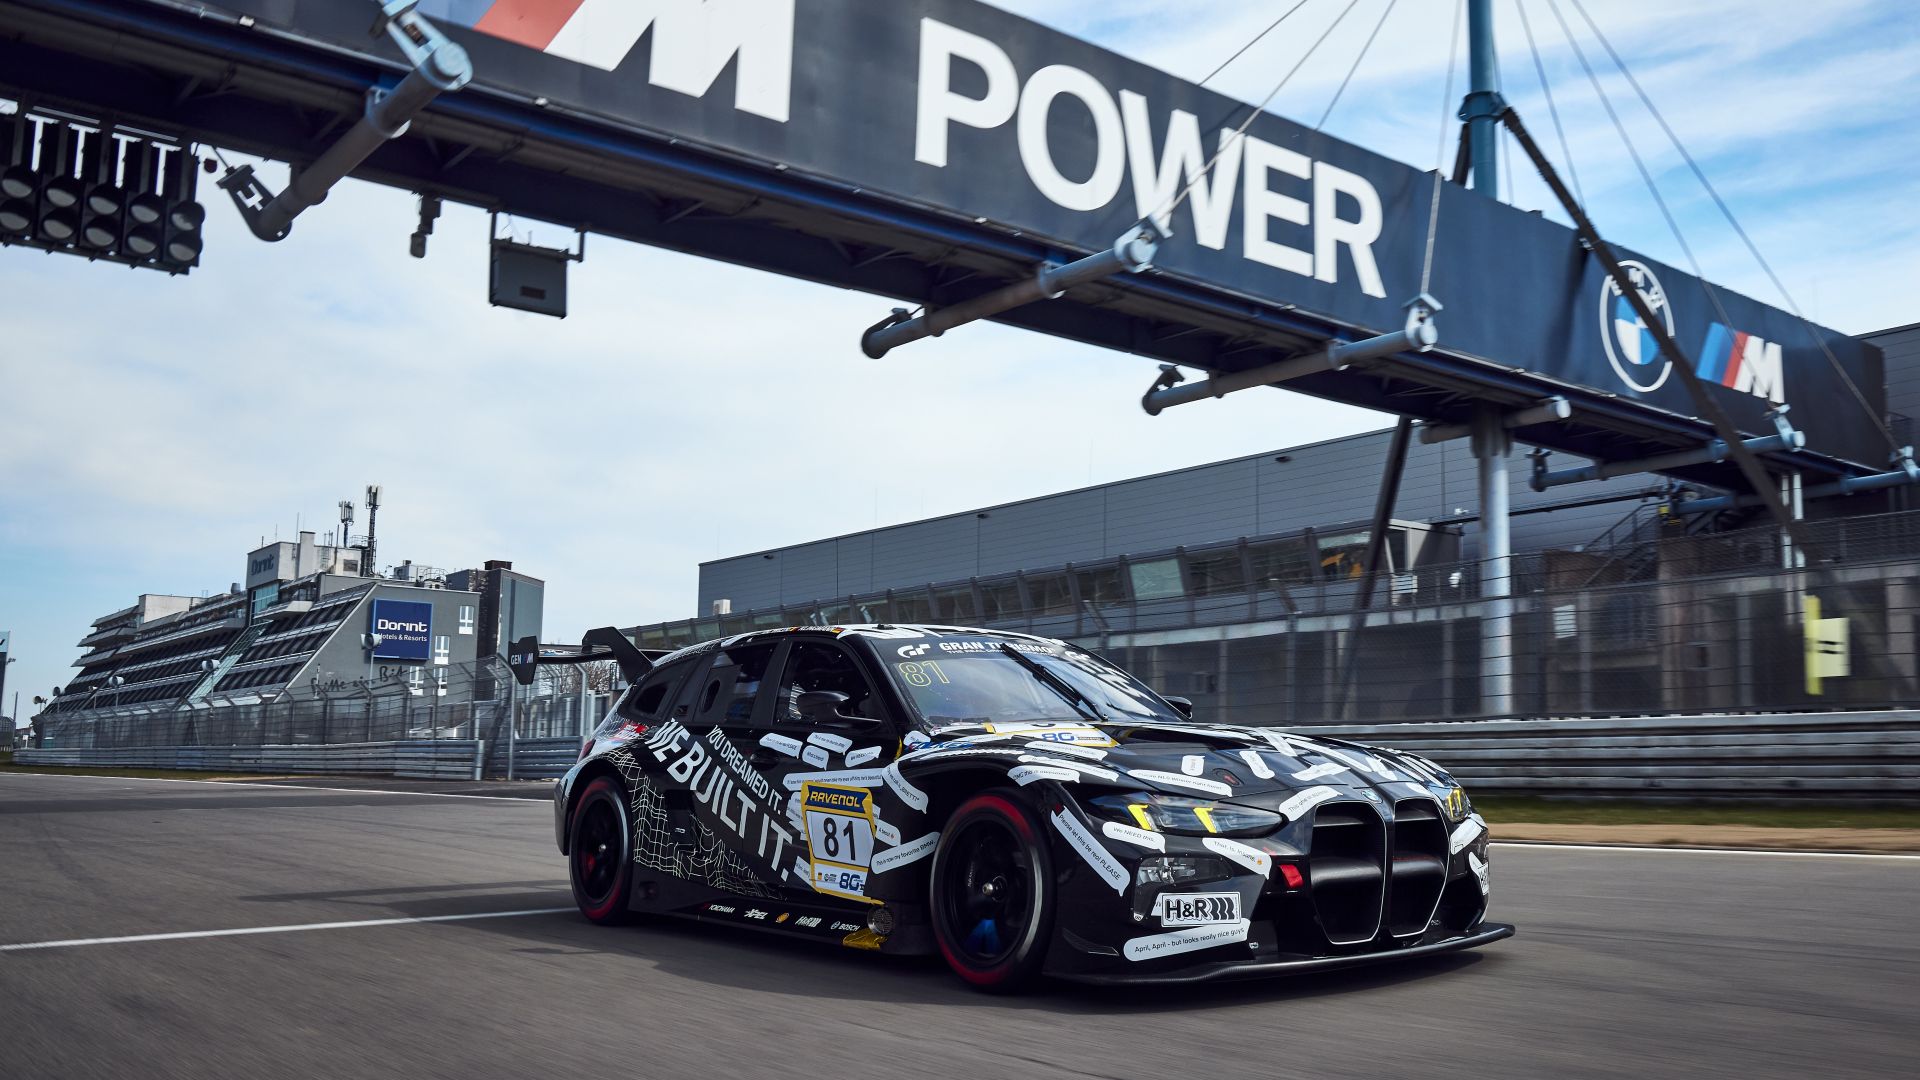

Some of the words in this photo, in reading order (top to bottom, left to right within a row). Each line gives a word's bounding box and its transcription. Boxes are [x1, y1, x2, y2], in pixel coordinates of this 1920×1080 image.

[915, 16, 1387, 300] POWER
[377, 618, 428, 632] Dorint
[510, 653, 522, 665] GEN
[939, 641, 985, 651] GRAN
[899, 660, 950, 687] 81
[644, 717, 691, 763] WE
[705, 724, 727, 751] YOU
[720, 741, 769, 800] DREAMED
[767, 788, 783, 815] IT.
[666, 740, 757, 840] BUILT
[810, 791, 860, 808] RAVENOL
[757, 812, 793, 883] IT.
[823, 816, 856, 861] 81
[1077, 835, 1086, 847] this
[1091, 851, 1101, 861] real
[1100, 859, 1121, 880] PLEASE
[838, 923, 861, 932] BOSCH
[1134, 944, 1151, 953] April,
[1152, 942, 1166, 951] April
[1171, 939, 1182, 947] but
[1182, 936, 1199, 945] looks
[1200, 933, 1217, 943] really
[1217, 930, 1230, 938] nice
[1230, 927, 1245, 937] guys
